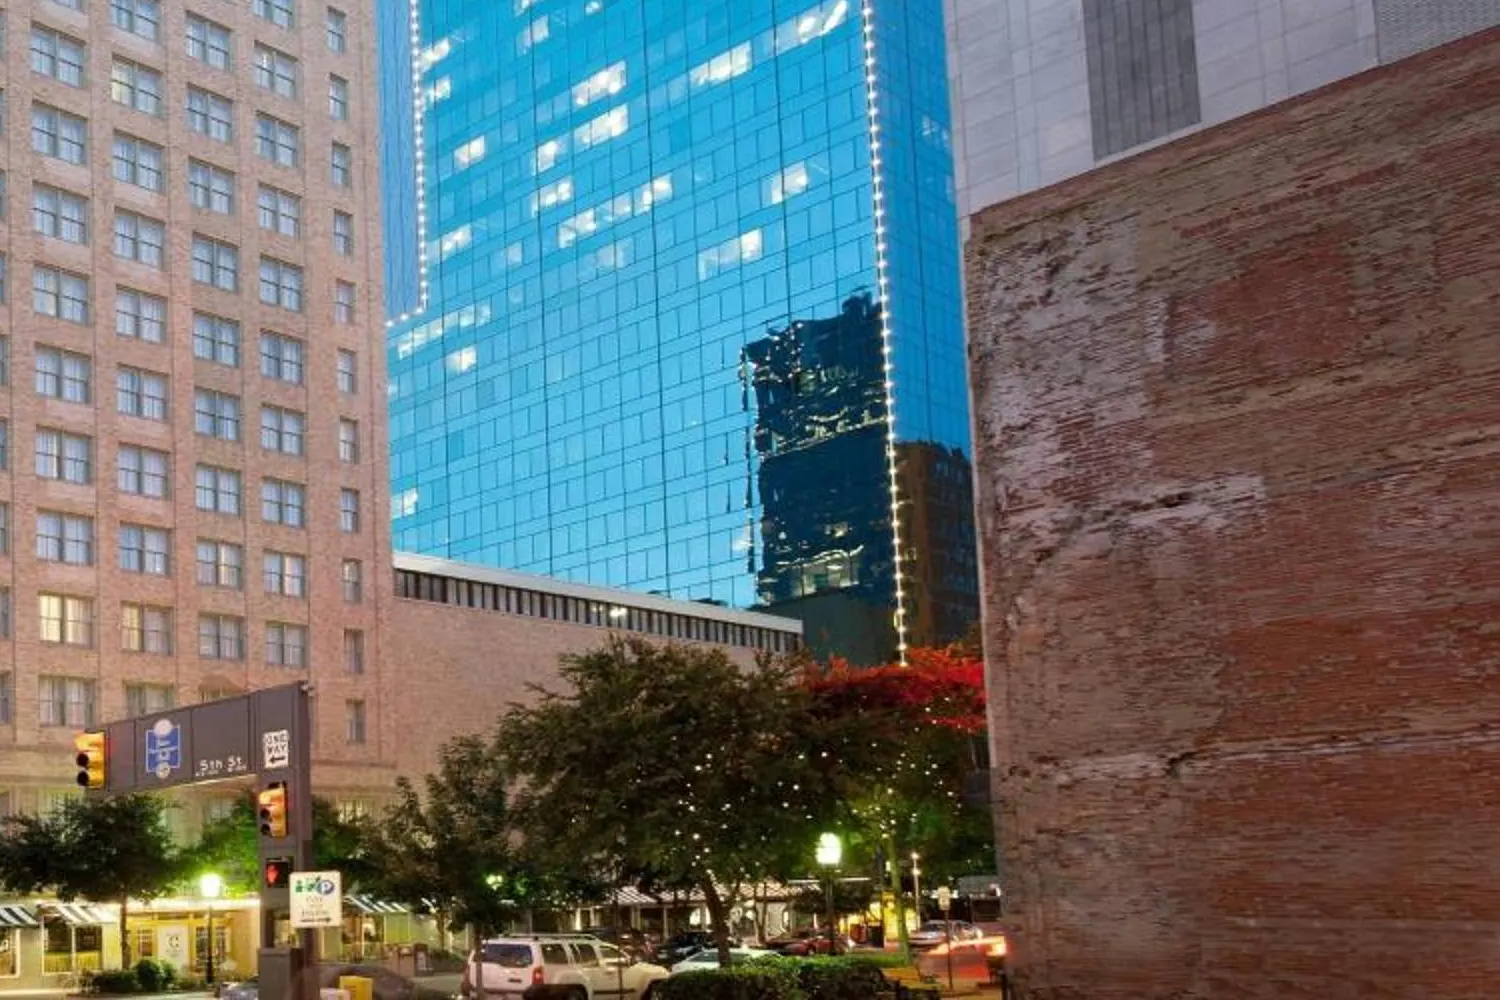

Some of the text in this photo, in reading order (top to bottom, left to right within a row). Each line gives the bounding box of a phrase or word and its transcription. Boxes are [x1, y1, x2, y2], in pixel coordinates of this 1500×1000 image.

[266, 733, 287, 744] ONE
[266, 744, 287, 755] WAY
[200, 755, 243, 771] 5th St
